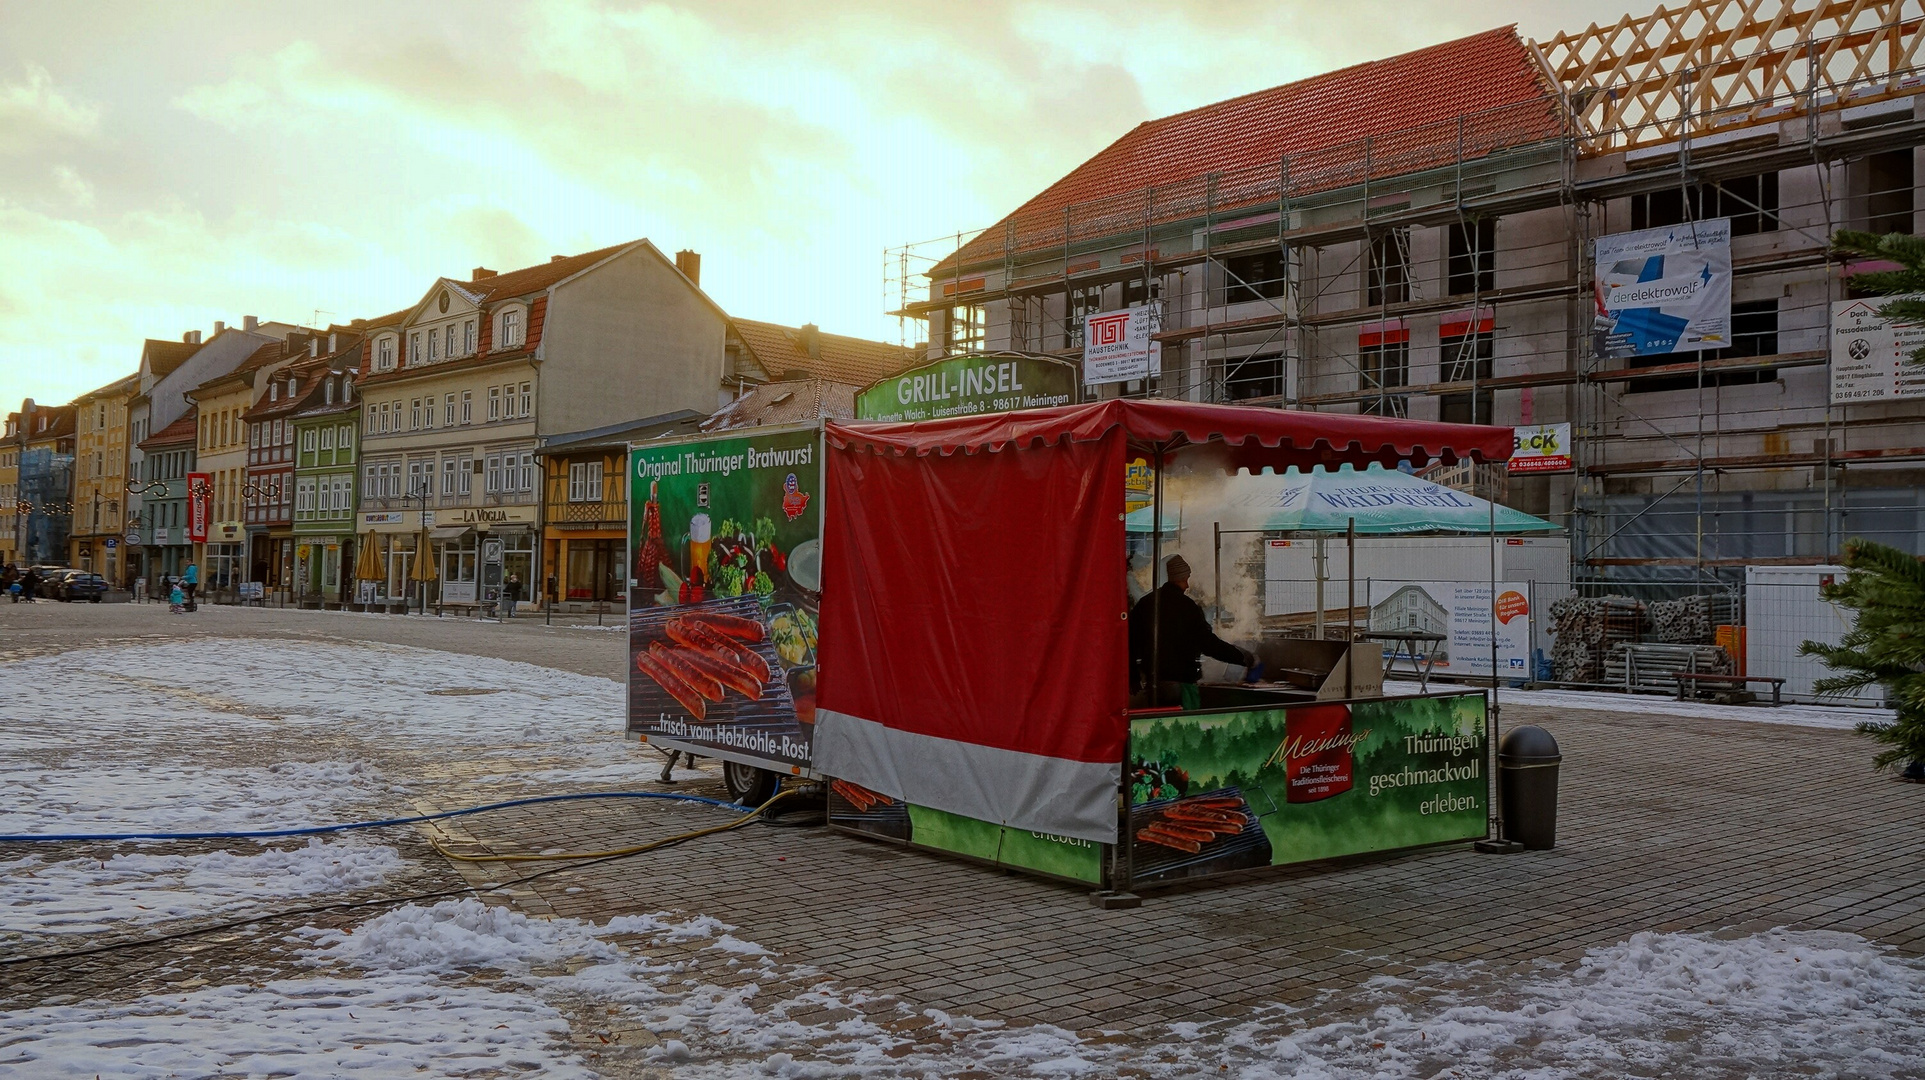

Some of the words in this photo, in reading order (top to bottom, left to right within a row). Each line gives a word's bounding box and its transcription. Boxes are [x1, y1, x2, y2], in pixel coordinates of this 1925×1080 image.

[1614, 282, 1698, 303] derelektrowolf
[1089, 314, 1130, 346] TGT
[1089, 342, 1129, 355] HAUSTECHNIK
[898, 362, 1022, 404] GRILL-INSEL
[904, 408, 926, 420] Walch
[932, 402, 977, 417] Luisenstraße
[979, 403, 985, 411] 8
[993, 397, 1020, 410] 98617
[1023, 393, 1069, 408] Meiningen
[637, 454, 681, 481] Original
[685, 450, 744, 476] Thüringer
[748, 444, 812, 469] Bratwurst
[1315, 492, 1473, 508] WALDQUELL
[464, 510, 475, 522] LA
[477, 509, 507, 522] VOGLIA
[690, 725, 713, 742] vom
[717, 724, 812, 762] Holzkohle-Rost.
[1265, 728, 1372, 769] Meininger
[1404, 734, 1478, 757] Thüringen
[1292, 774, 1348, 786] Traditionsfleischerei
[1300, 766, 1311, 774] Die
[1312, 764, 1340, 774] Thüringer
[1370, 759, 1478, 796] geschmackvoll
[1420, 792, 1479, 815] erleben.
